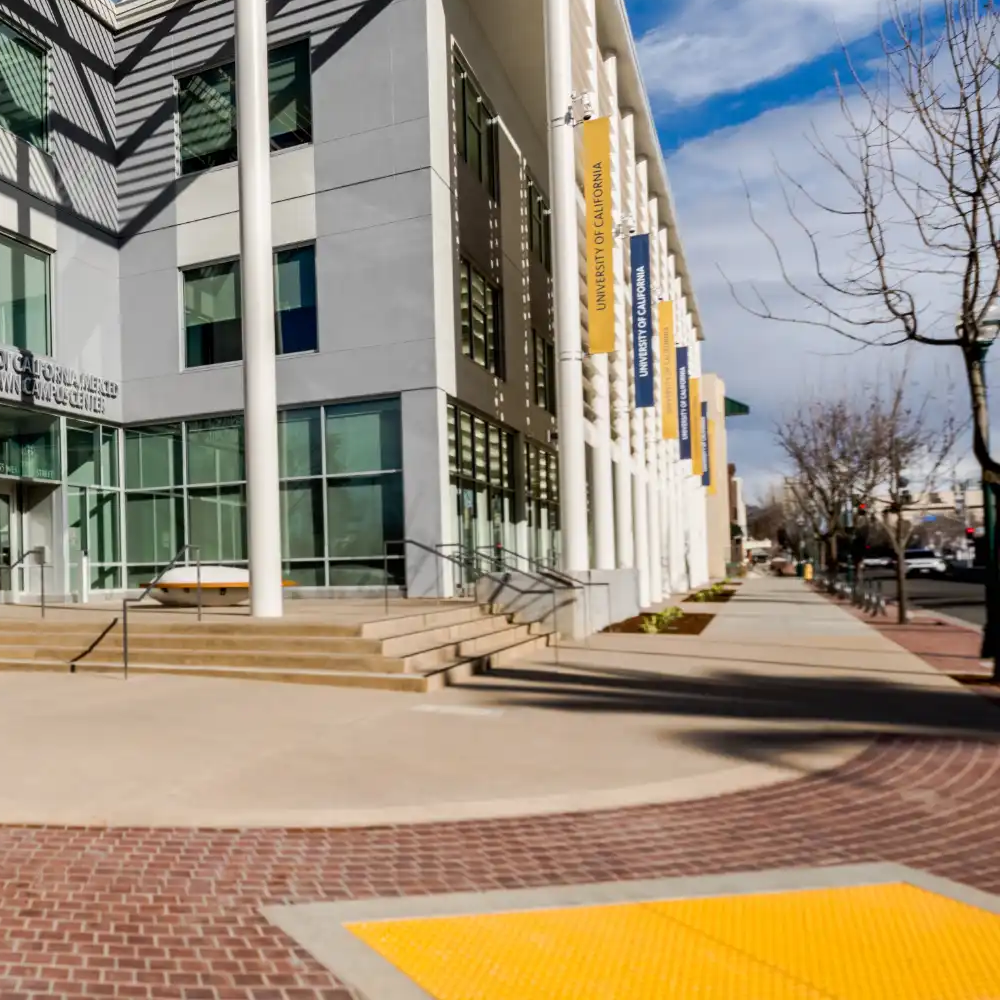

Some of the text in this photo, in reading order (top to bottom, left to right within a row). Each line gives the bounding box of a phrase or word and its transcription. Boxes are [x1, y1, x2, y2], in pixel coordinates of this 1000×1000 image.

[592, 161, 605, 311] UNIVERSITY OF CALIFORNIA
[635, 265, 649, 377] UNIVERSITY OF CALIFORNIA
[21, 376, 68, 407] CAMPUS
[67, 388, 105, 415] CENTER
[79, 372, 119, 400] MERCED
[679, 366, 689, 442] UNIVERSITY OF CALIFORNIA
